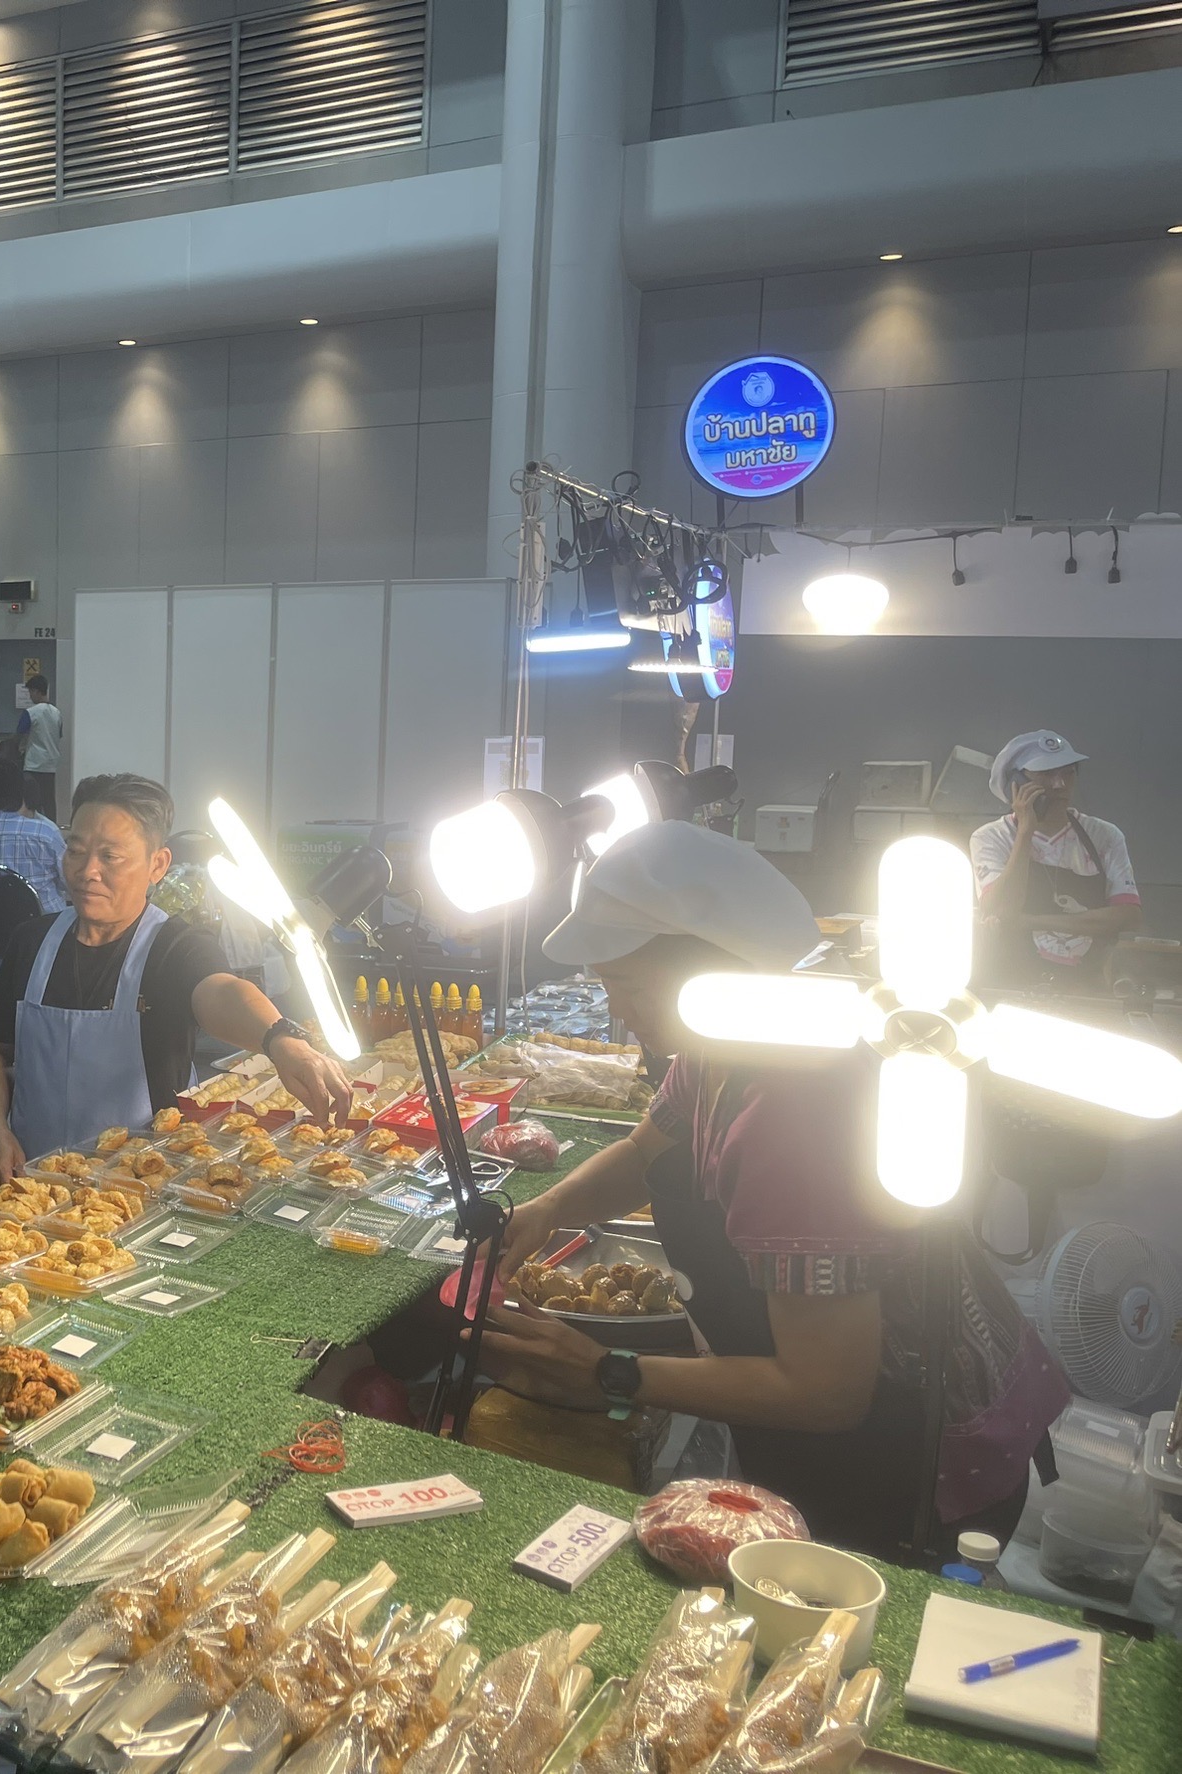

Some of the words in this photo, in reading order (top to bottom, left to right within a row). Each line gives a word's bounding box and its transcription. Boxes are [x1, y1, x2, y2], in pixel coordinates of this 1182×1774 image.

[704, 411, 816, 442] บ้านปลาทู
[725, 439, 797, 469] มหาชัย
[34, 627, 43, 638] FE
[44, 627, 56, 638] 24
[345, 1499, 395, 1512] OTOP
[399, 1487, 448, 1504] 100
[547, 1546, 581, 1574] OTOP
[568, 1522, 607, 1547] 500
